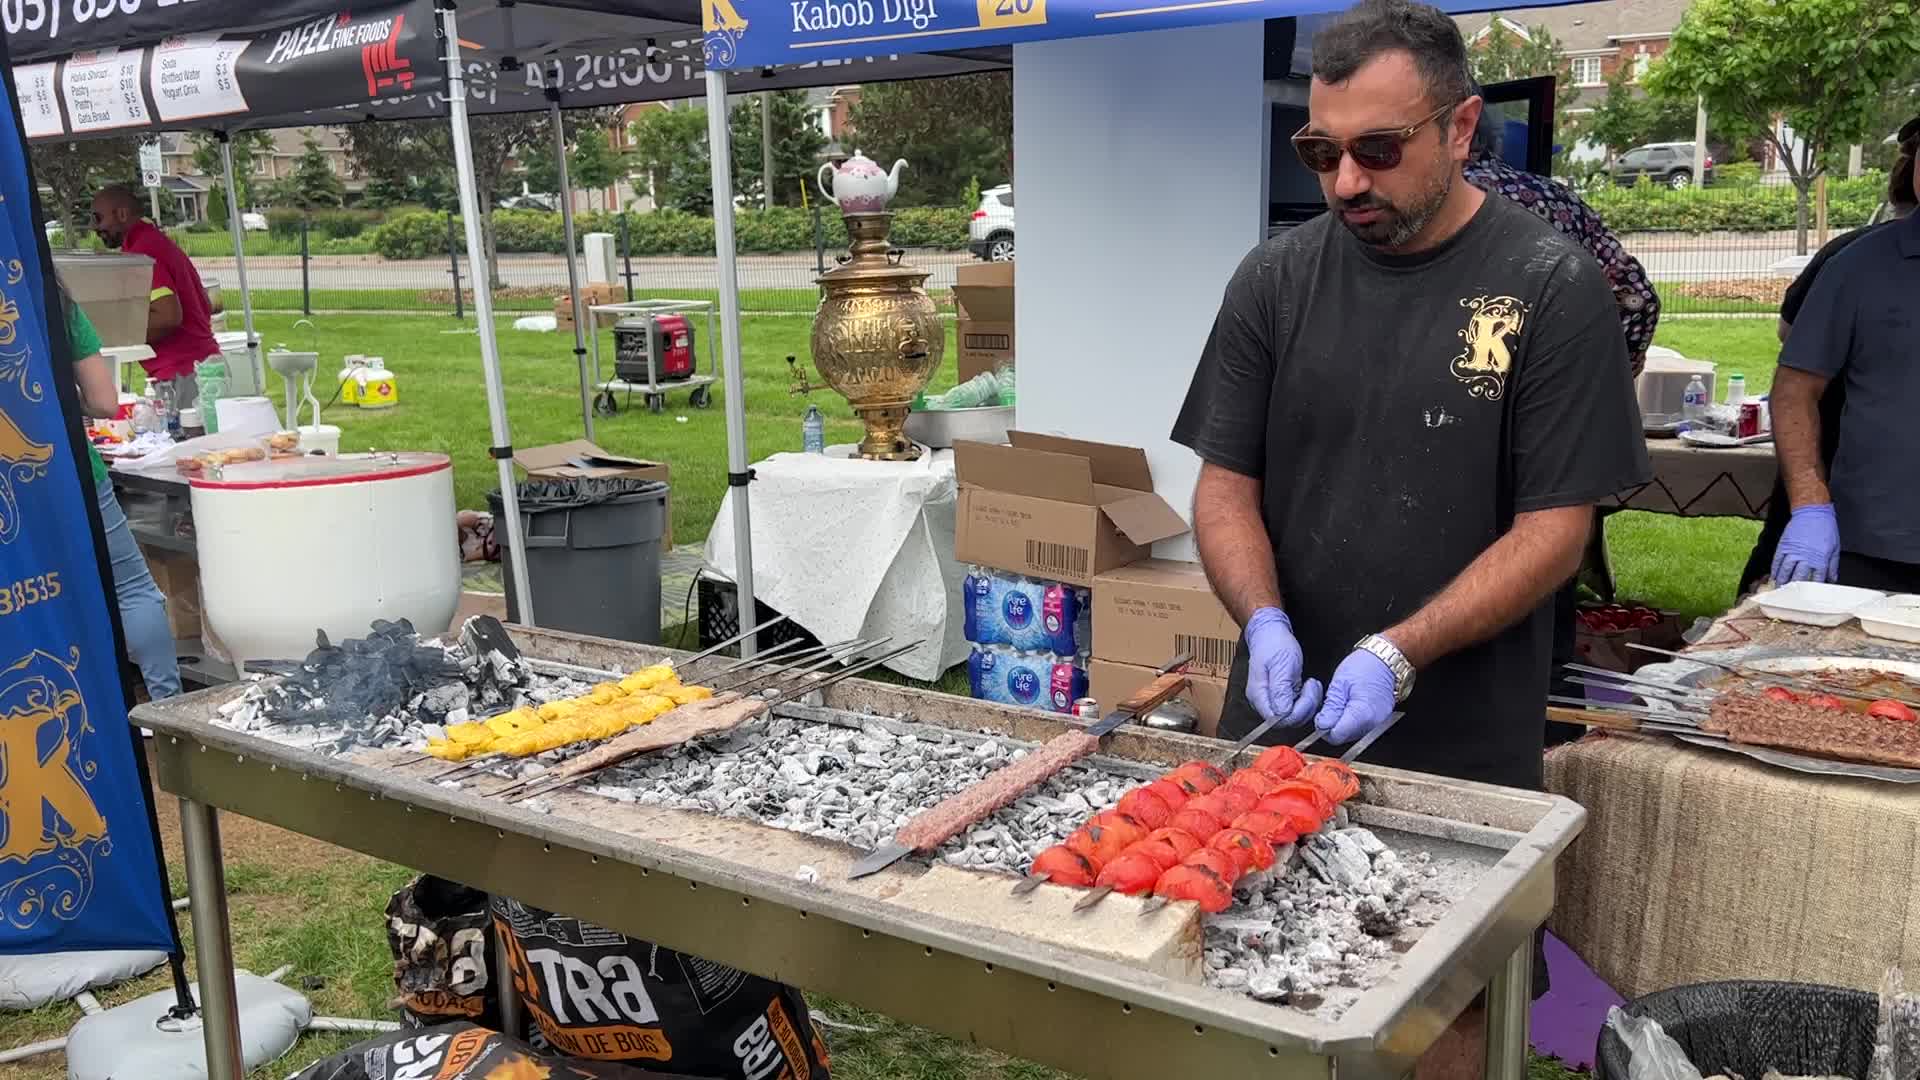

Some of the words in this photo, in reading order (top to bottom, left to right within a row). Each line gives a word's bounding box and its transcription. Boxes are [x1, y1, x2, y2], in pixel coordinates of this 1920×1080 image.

[790, 0, 874, 33] Kabob
[265, 13, 338, 64] PAEEZ
[331, 26, 356, 49] FINE
[355, 19, 392, 44] FOODS
[120, 79, 134, 91] $10
[1007, 593, 1027, 606] Pure
[1011, 671, 1034, 683] Pure
[584, 1032, 614, 1054] DE
[613, 1031, 660, 1054] BOIS
